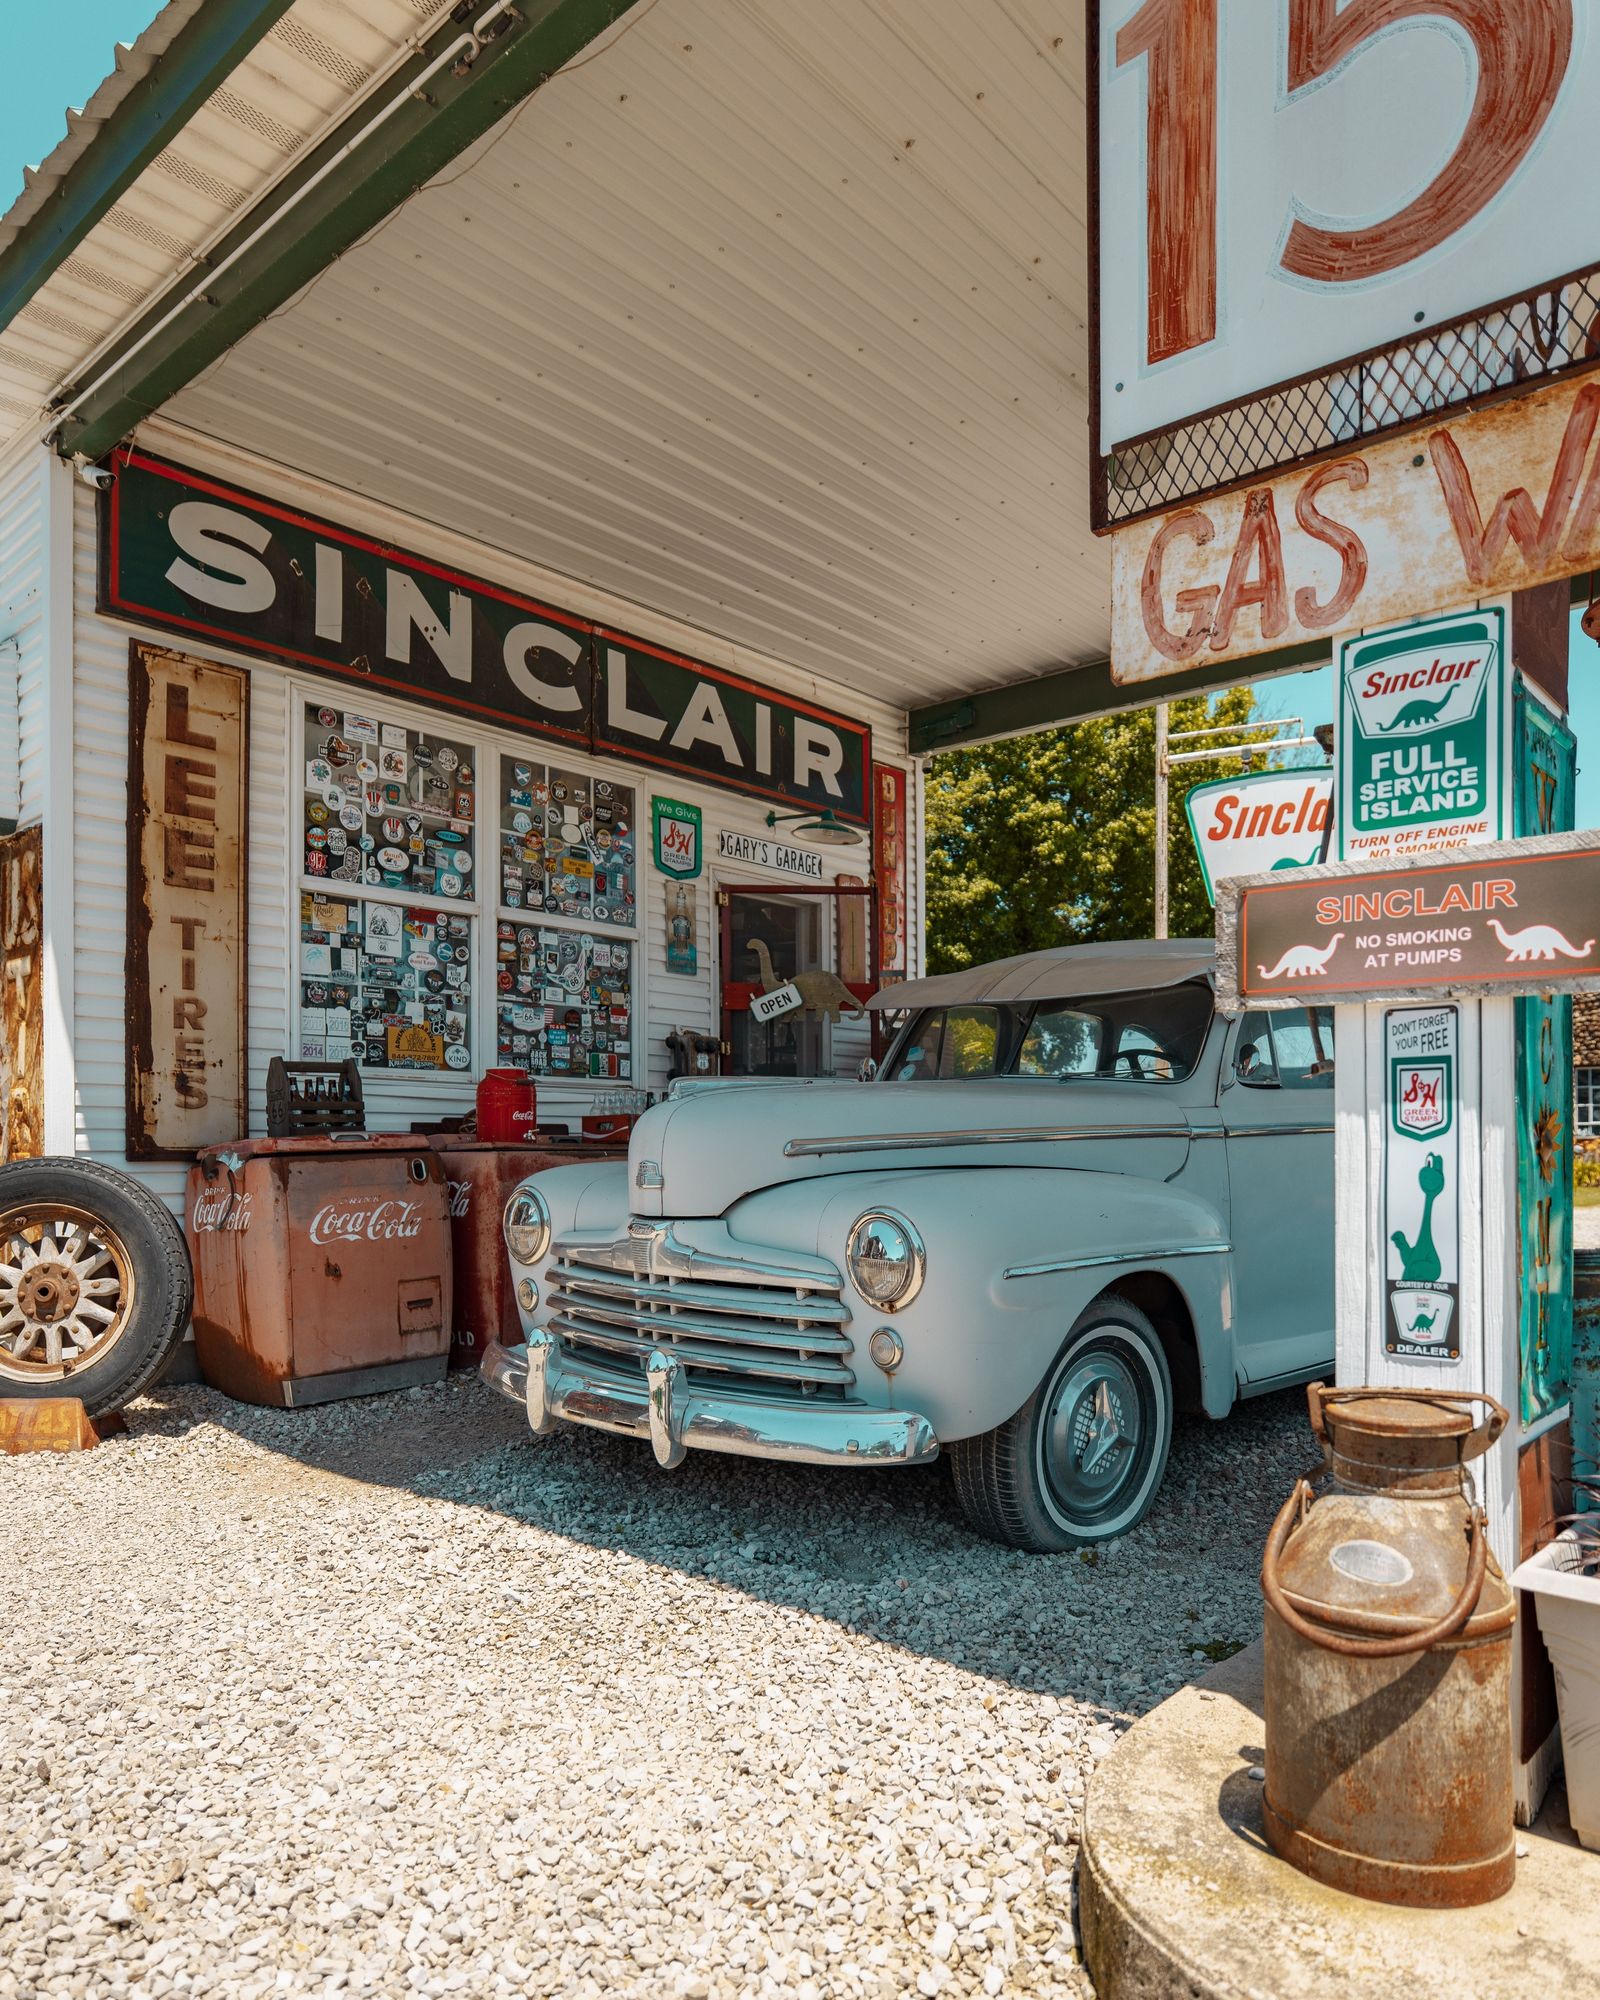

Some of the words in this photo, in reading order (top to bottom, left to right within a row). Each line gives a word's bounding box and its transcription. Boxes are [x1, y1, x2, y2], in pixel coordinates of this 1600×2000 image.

[1141, 457, 1369, 661] GAS
[166, 501, 844, 798] SINCLAIR
[1361, 657, 1482, 700] Sinclair
[1370, 740, 1467, 780] FULL
[164, 683, 217, 893] LEE
[1359, 766, 1479, 802] SERVICE
[459, 798, 470, 807] 66
[657, 802, 673, 814] We
[675, 806, 698, 820] Give
[1359, 788, 1479, 823] ISLAND
[1350, 833, 1389, 850] TURN
[1394, 831, 1424, 846] OFF
[1428, 821, 1489, 840] ENGINE
[663, 851, 692, 862] GREEN
[663, 857, 692, 868] STAMPS
[726, 834, 769, 864] GARY'S
[775, 847, 818, 876] GARAGE
[314, 904, 336, 917] Route
[1315, 879, 1518, 925] SINCLAIR
[1355, 932, 1381, 948] NO
[1386, 927, 1472, 946] SMOKING
[1364, 953, 1389, 968] AT
[1394, 948, 1462, 966] PUMPS
[169, 914, 208, 1110] TIRES
[759, 990, 794, 1016] OPEN
[524, 1013, 534, 1021] 66
[1391, 1017, 1417, 1036] DON'T
[1417, 1011, 1450, 1031] FORGET
[302, 1046, 324, 1057] 2014
[1395, 1036, 1419, 1051] YOUR
[1420, 1027, 1449, 1054] FREE
[448, 1055, 468, 1063] KIND
[1402, 1071, 1440, 1108] S&H
[1404, 1107, 1439, 1116] GREEN
[1404, 1115, 1439, 1123] STAMPS
[309, 1199, 424, 1246] Coca-Cola
[1395, 1280, 1424, 1289] COURTESY
[1425, 1281, 1432, 1289] OF
[1433, 1283, 1449, 1291] YOUR
[1396, 1343, 1449, 1357] DEALER
